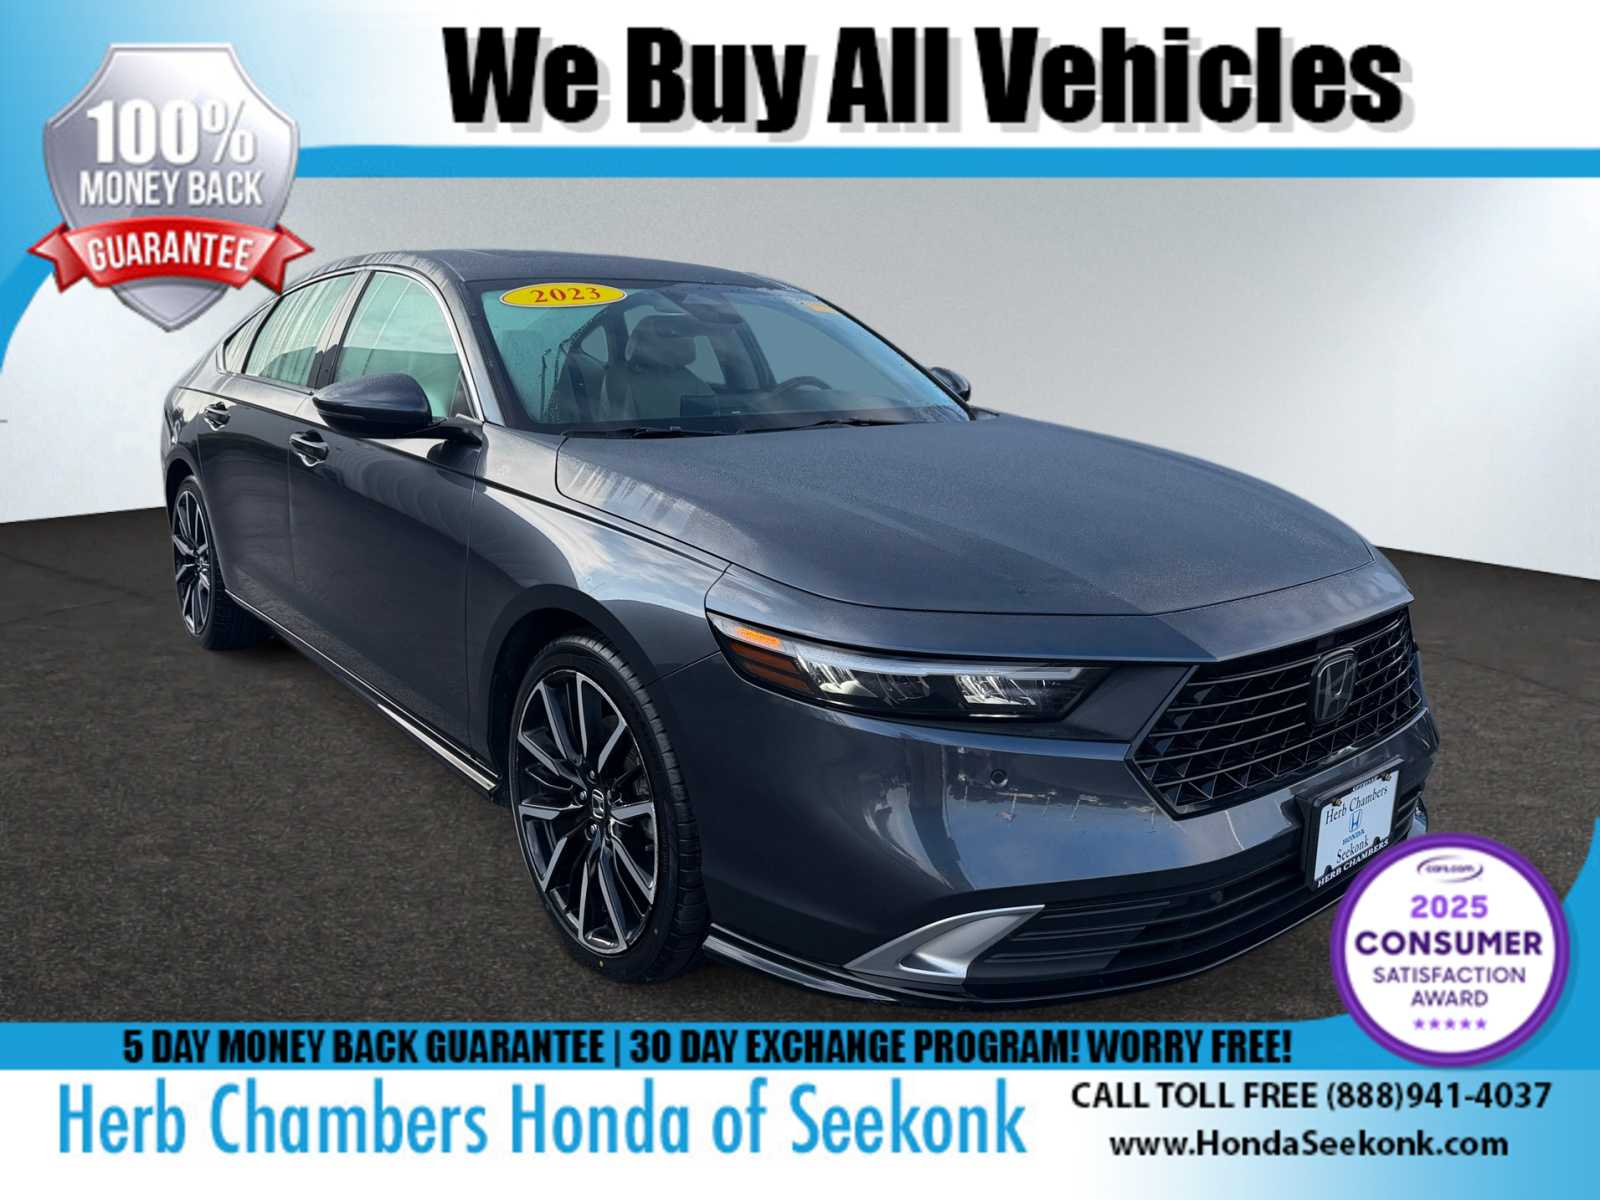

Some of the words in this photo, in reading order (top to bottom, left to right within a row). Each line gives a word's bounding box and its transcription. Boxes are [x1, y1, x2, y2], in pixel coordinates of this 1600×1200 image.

[529, 287, 602, 304] 2023
[1325, 799, 1347, 825] Herb
[1349, 785, 1388, 812] Chambers
[1317, 864, 1342, 888] HERB
[1343, 838, 1390, 872] CHAMBERS
[1336, 836, 1369, 864] Seekonk
